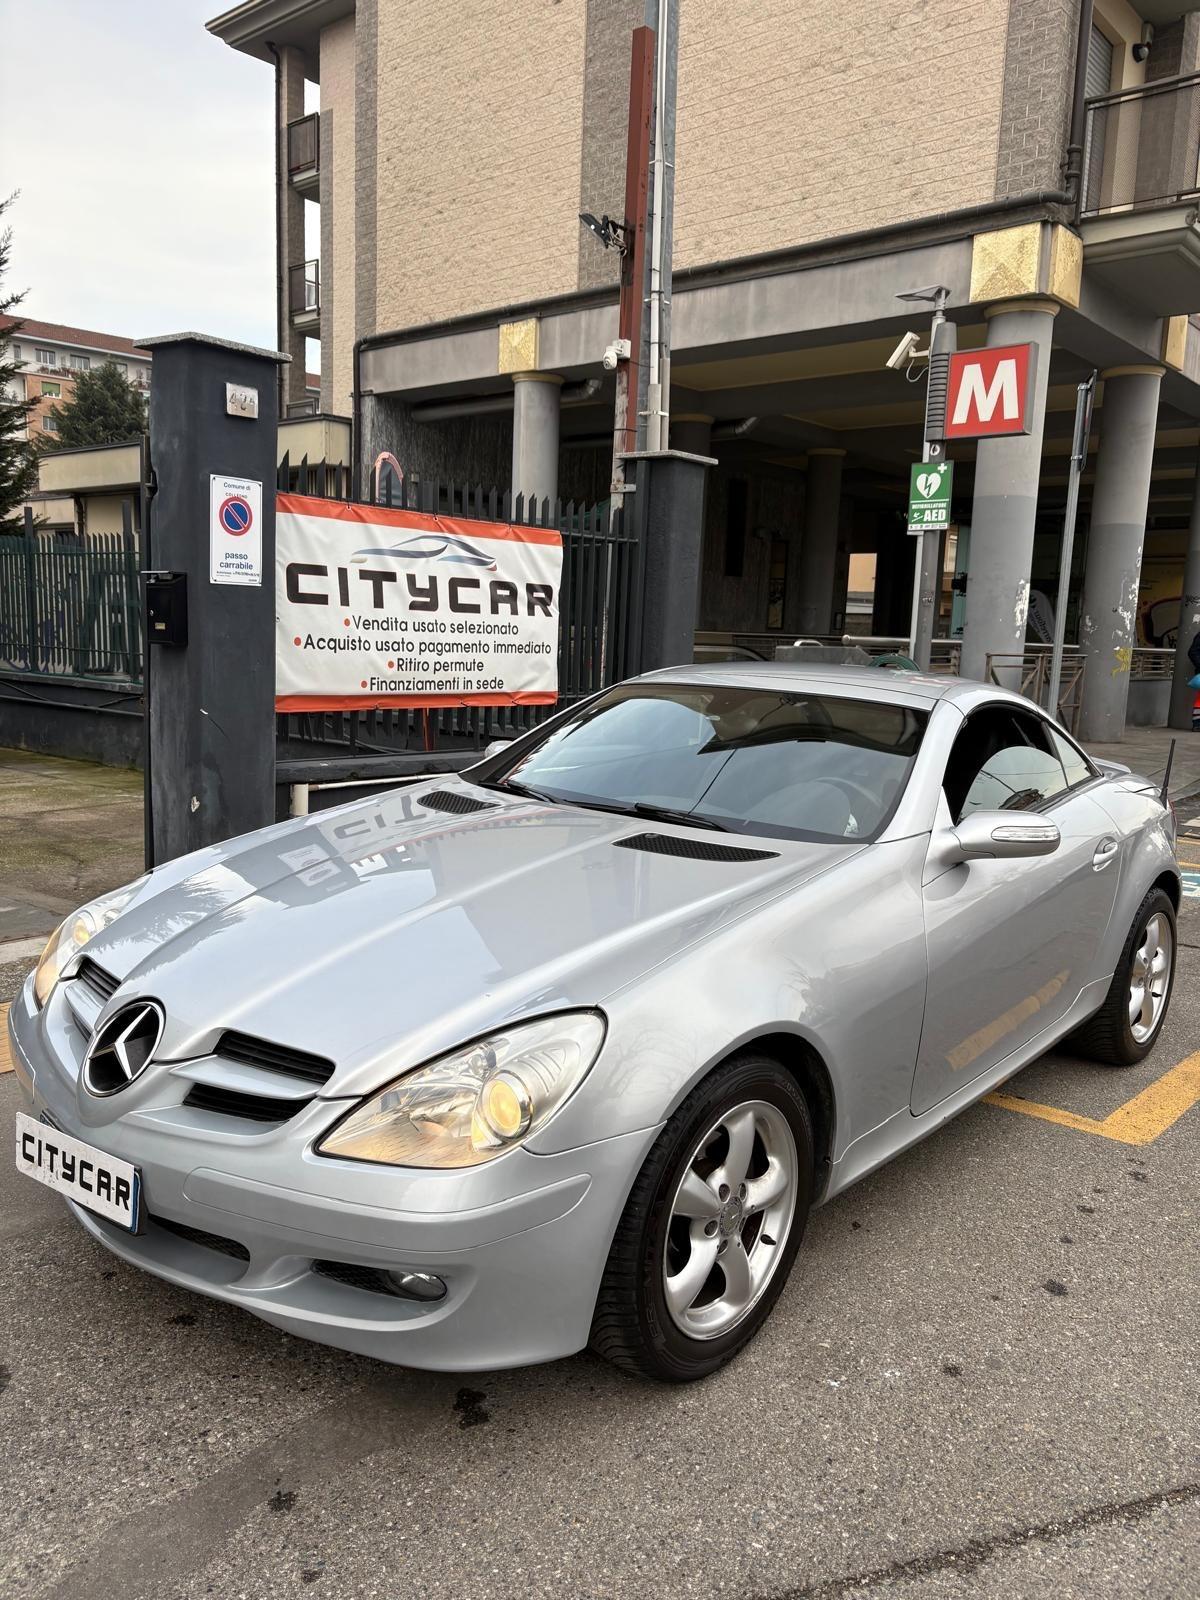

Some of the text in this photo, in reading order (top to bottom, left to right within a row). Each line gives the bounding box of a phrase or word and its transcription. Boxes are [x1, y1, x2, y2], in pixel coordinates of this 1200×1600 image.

[952, 359, 1019, 424] M
[223, 482, 245, 490] Comune
[923, 509, 946, 522] AED
[224, 552, 248, 560] passo
[219, 560, 254, 570] carrabile
[286, 562, 554, 618] CITYCAR
[352, 616, 519, 636] Vendita usato selezionato
[303, 634, 551, 656] Acquisto usato pagamento immediato
[396, 658, 484, 674] Ritiro permute
[370, 677, 504, 692] Finanziamenti in sede
[22, 1132, 130, 1211] CITYCAR
